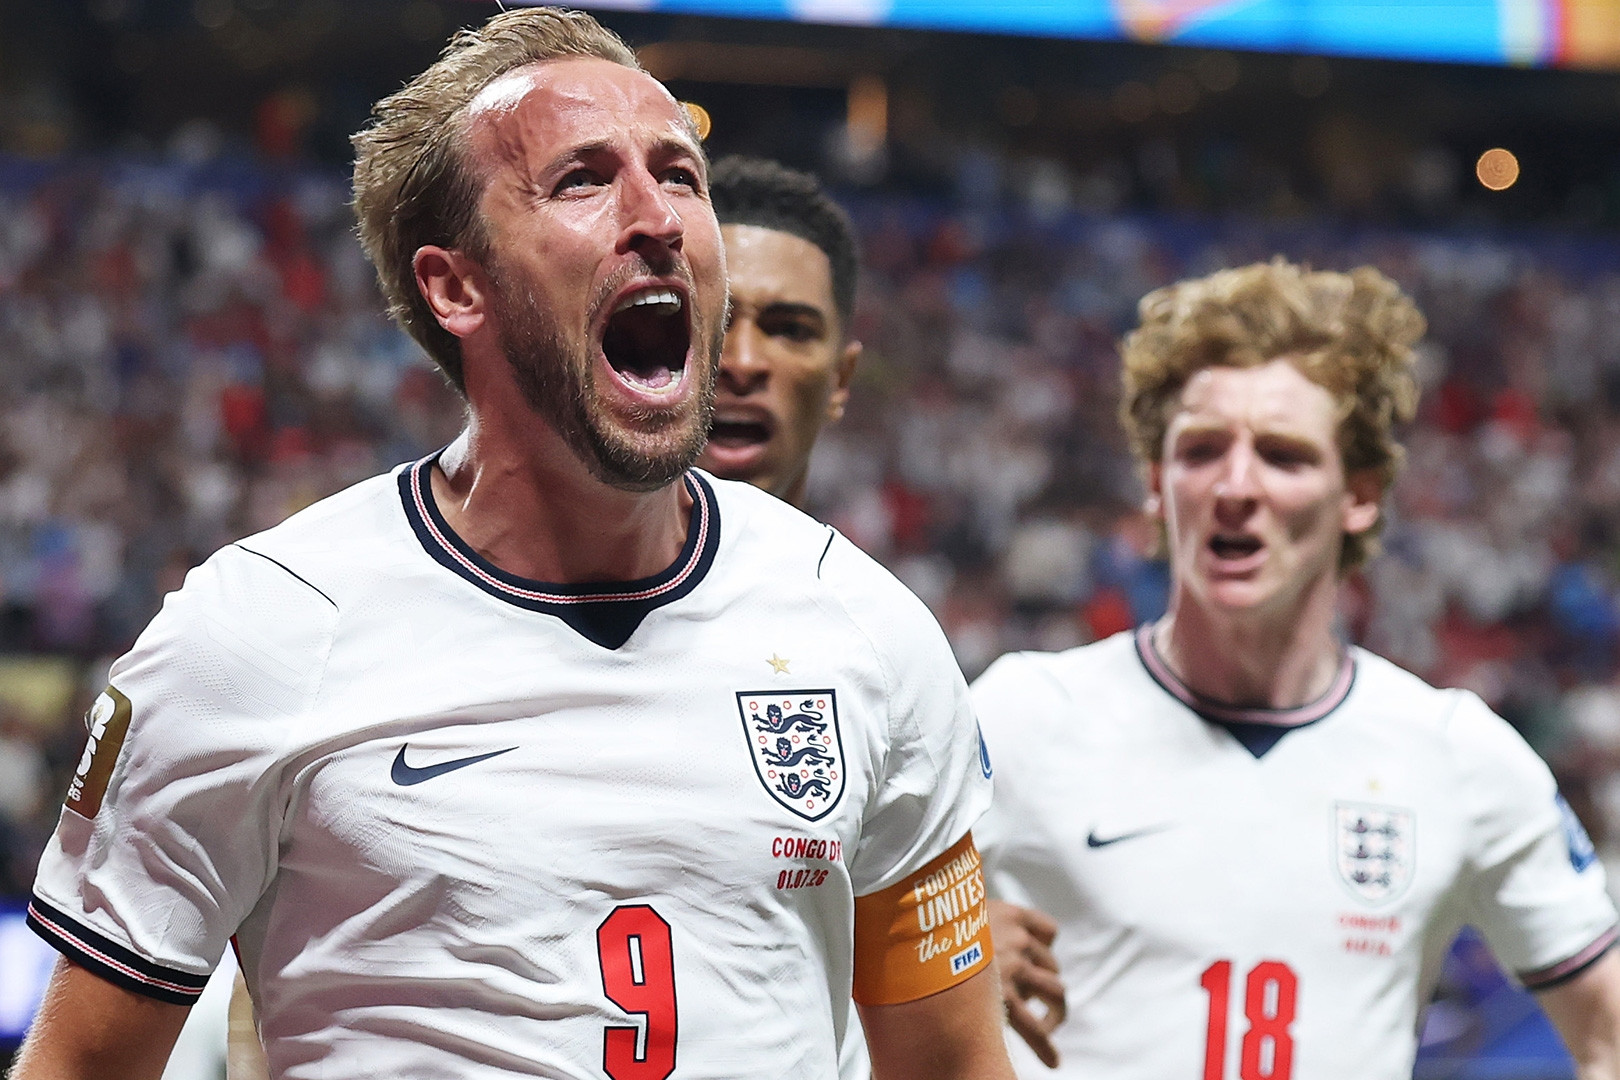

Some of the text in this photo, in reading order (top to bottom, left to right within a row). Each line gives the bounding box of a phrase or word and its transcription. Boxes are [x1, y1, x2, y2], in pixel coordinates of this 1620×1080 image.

[772, 837, 827, 860] CONGO
[777, 869, 829, 889] 01.07.26
[914, 846, 980, 903] FOOTBALL
[917, 868, 985, 932] UNITES
[915, 932, 953, 963] the
[954, 947, 981, 970] FIFA
[596, 904, 678, 1080] 9
[1201, 959, 1297, 1080] 18
